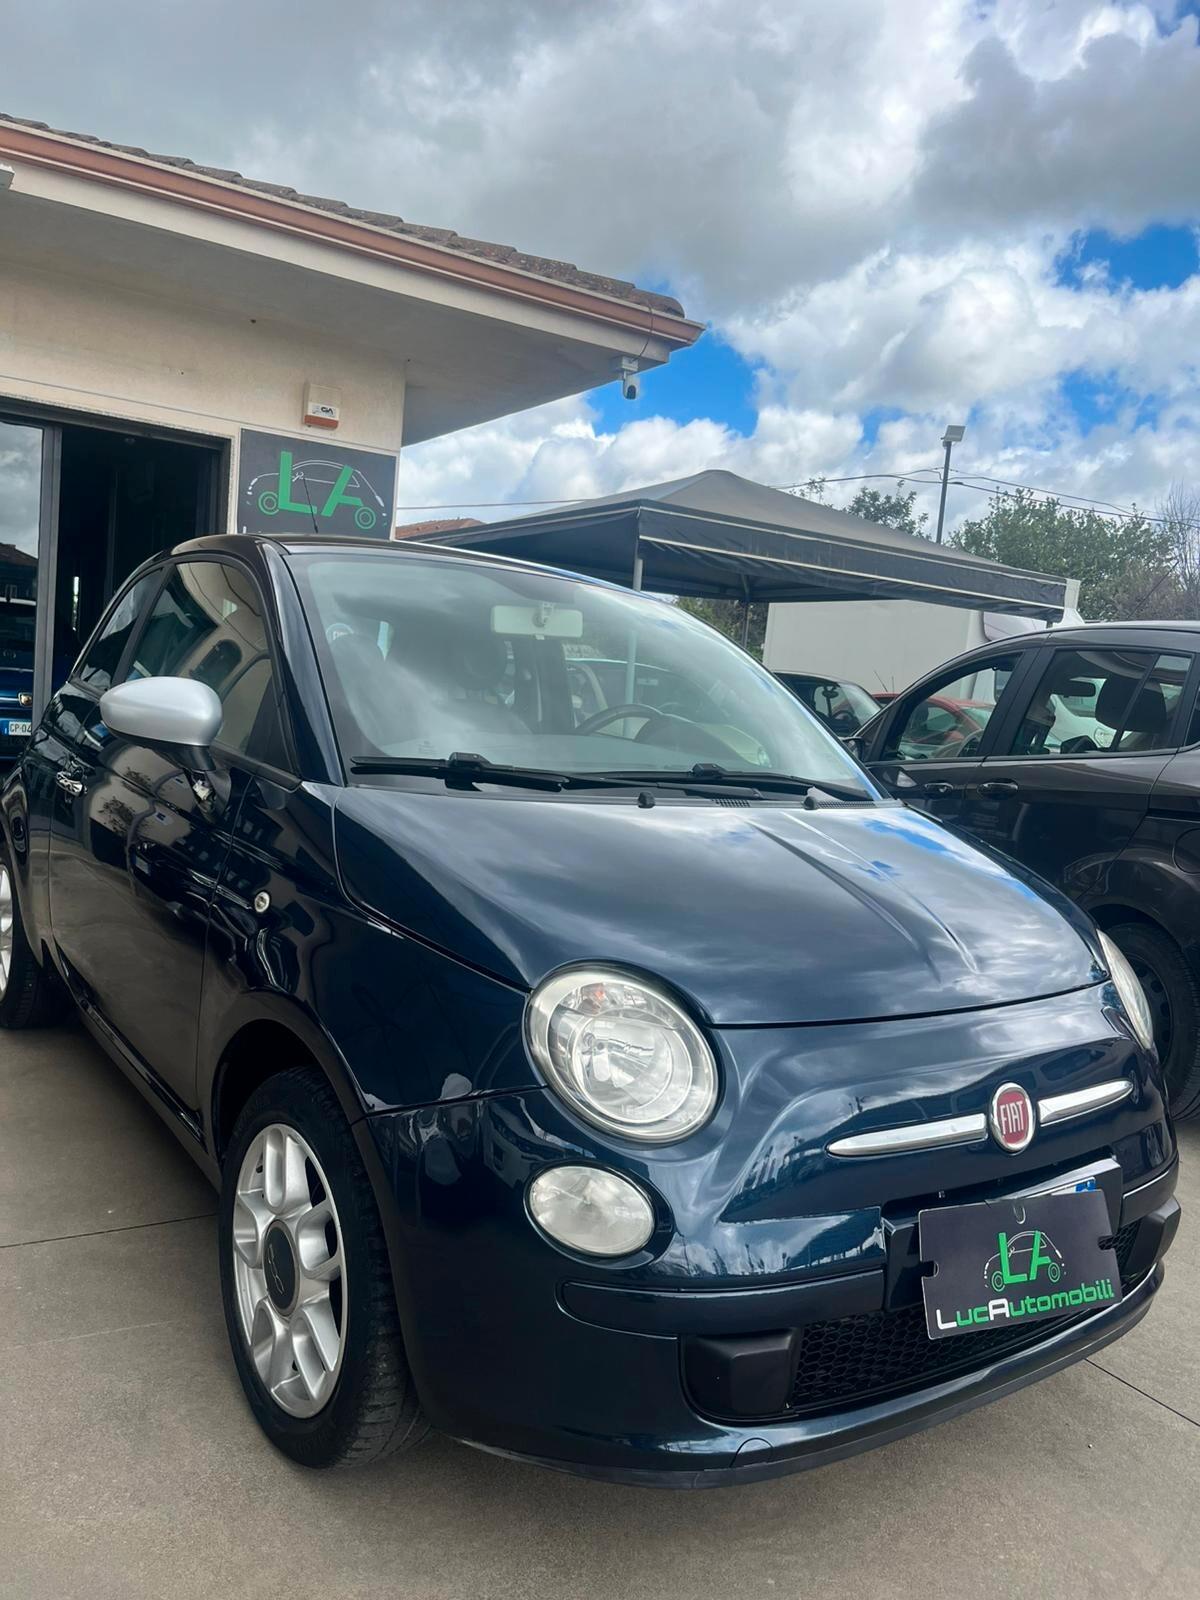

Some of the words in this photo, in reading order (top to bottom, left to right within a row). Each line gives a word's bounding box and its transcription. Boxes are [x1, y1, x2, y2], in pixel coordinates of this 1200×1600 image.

[278, 451, 364, 517] LA
[1000, 1100, 1024, 1135] FIAT
[998, 1230, 1051, 1284] LA
[936, 1279, 1115, 1330] LucAutomobili
